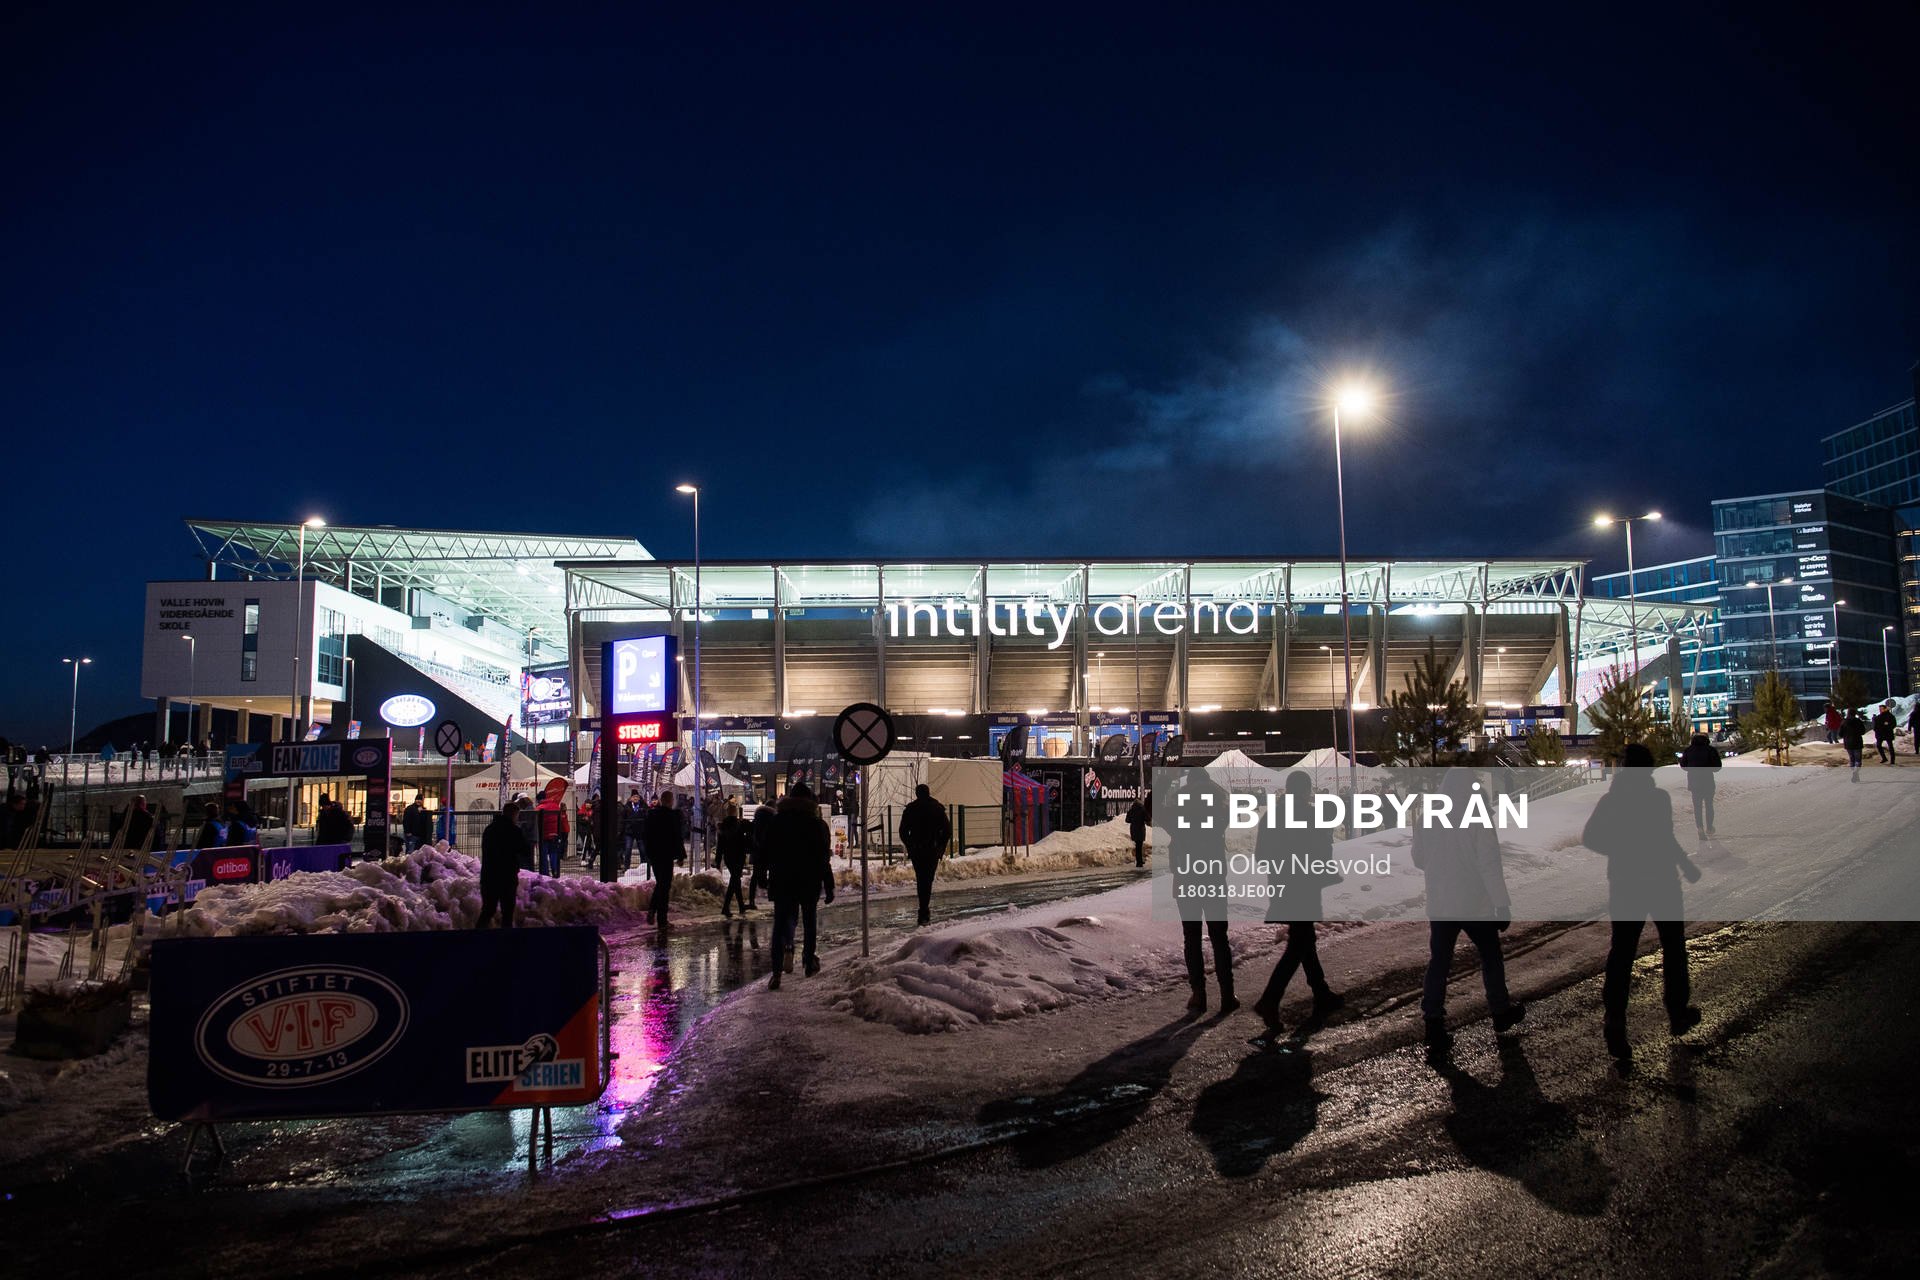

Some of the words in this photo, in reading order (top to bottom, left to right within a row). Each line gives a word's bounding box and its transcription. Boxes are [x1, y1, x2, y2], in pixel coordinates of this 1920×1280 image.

[160, 598, 190, 607] VALLE
[193, 598, 225, 607] HOVIN
[160, 608, 234, 618] VIDEREGÅENDE
[890, 591, 1077, 650] intility
[1094, 600, 1259, 636] arena
[159, 621, 191, 631] SKOLE
[618, 651, 638, 691] P
[1130, 713, 1138, 723] 12
[618, 723, 660, 739] STENGT
[275, 746, 338, 772] FANZONE
[1101, 786, 1137, 799] Domino's
[216, 862, 249, 875] altibox
[241, 975, 355, 1008] STIFTET
[265, 1051, 348, 1077] 29-7-13
[471, 1049, 523, 1078] ELITE
[521, 1063, 581, 1087] SERIEN
